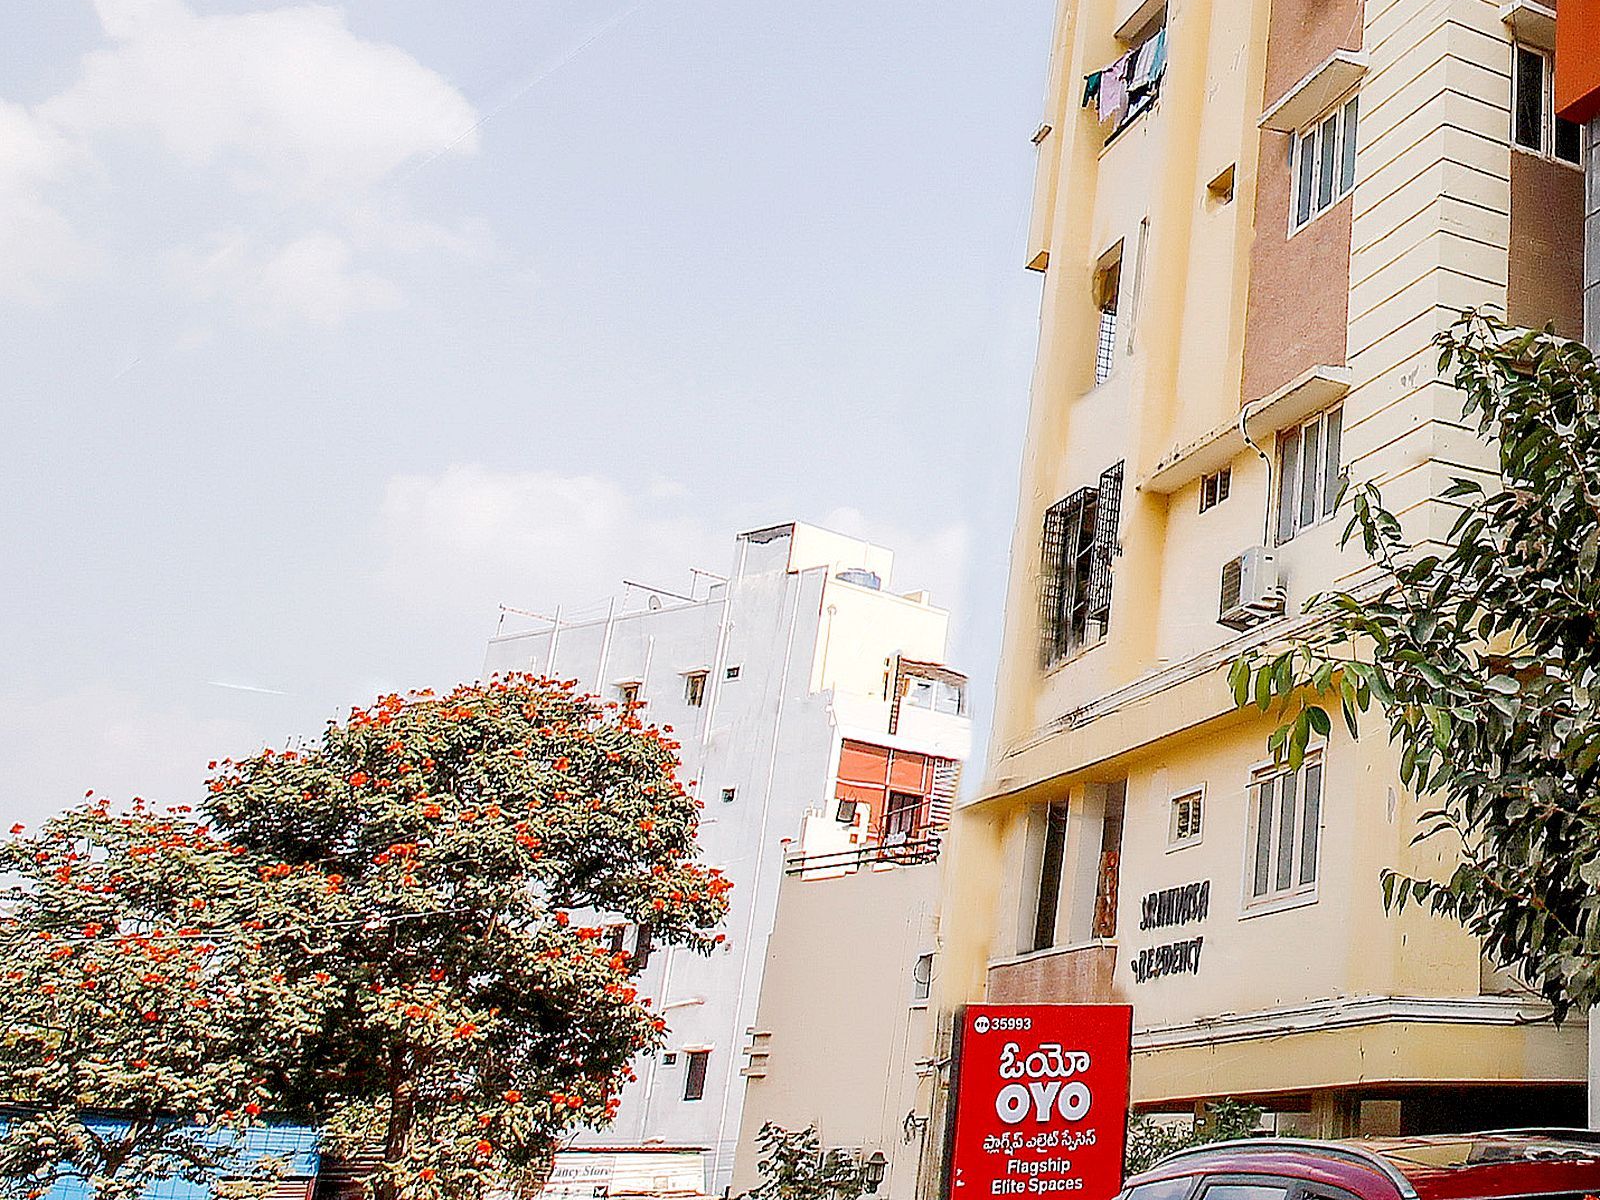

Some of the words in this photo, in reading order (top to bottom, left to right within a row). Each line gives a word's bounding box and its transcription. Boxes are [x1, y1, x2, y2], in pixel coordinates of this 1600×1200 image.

[991, 1017, 1032, 1031] 35993
[999, 1043, 1091, 1079] ఓయో
[996, 1081, 1092, 1123] OYO
[1007, 1157, 1071, 1176] Flagship
[991, 1180, 1026, 1195] Elite
[1028, 1178, 1083, 1195] Spaces
